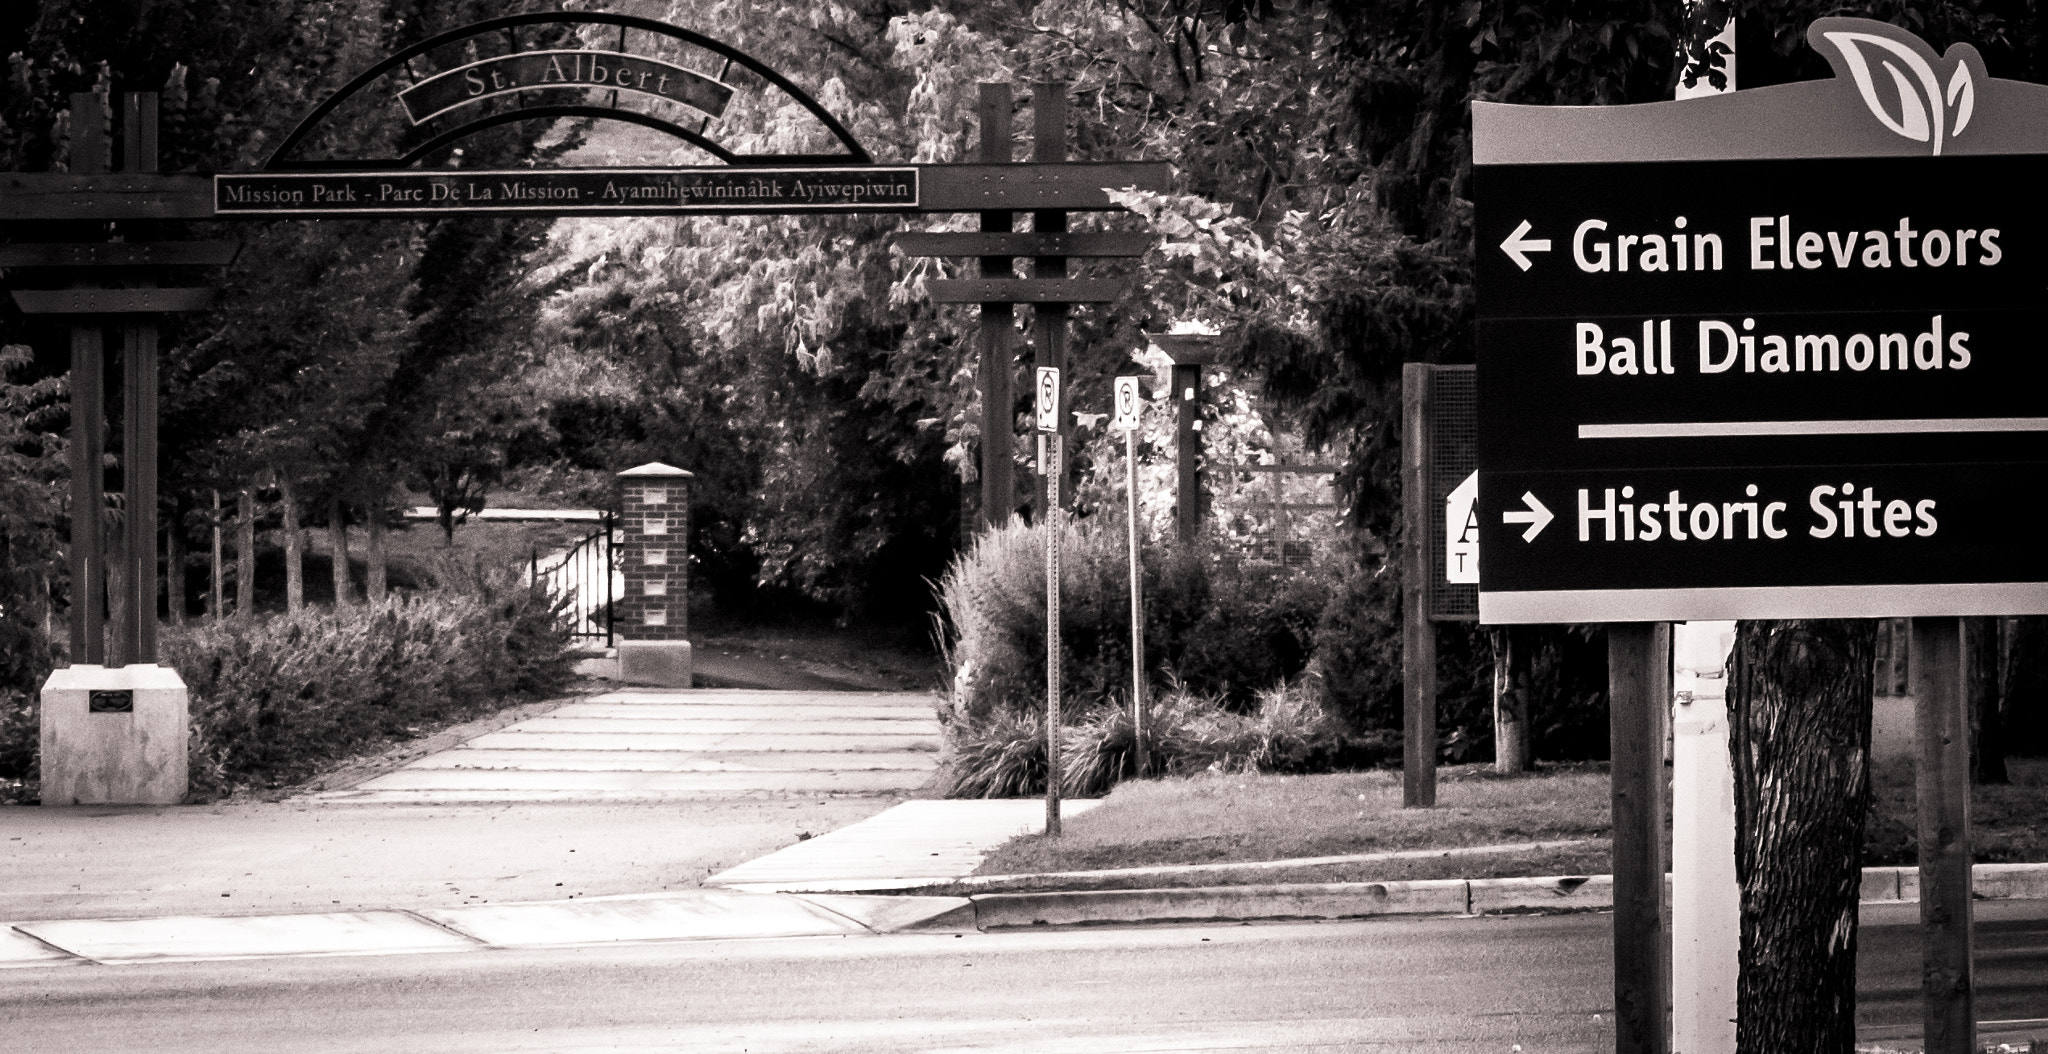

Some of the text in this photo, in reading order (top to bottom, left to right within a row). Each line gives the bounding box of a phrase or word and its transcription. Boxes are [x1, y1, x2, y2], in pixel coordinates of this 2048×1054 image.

[465, 54, 671, 96] St. Albert
[225, 184, 303, 203] Mission
[312, 183, 356, 202] Park
[379, 183, 423, 201] Parc
[430, 182, 460, 201] De
[468, 182, 493, 200] La
[501, 181, 579, 200] Mission
[1573, 214, 2002, 273] Grain Elevators
[1576, 314, 1972, 376] Ball Diamonds
[1578, 482, 1938, 542] Historic Sites
